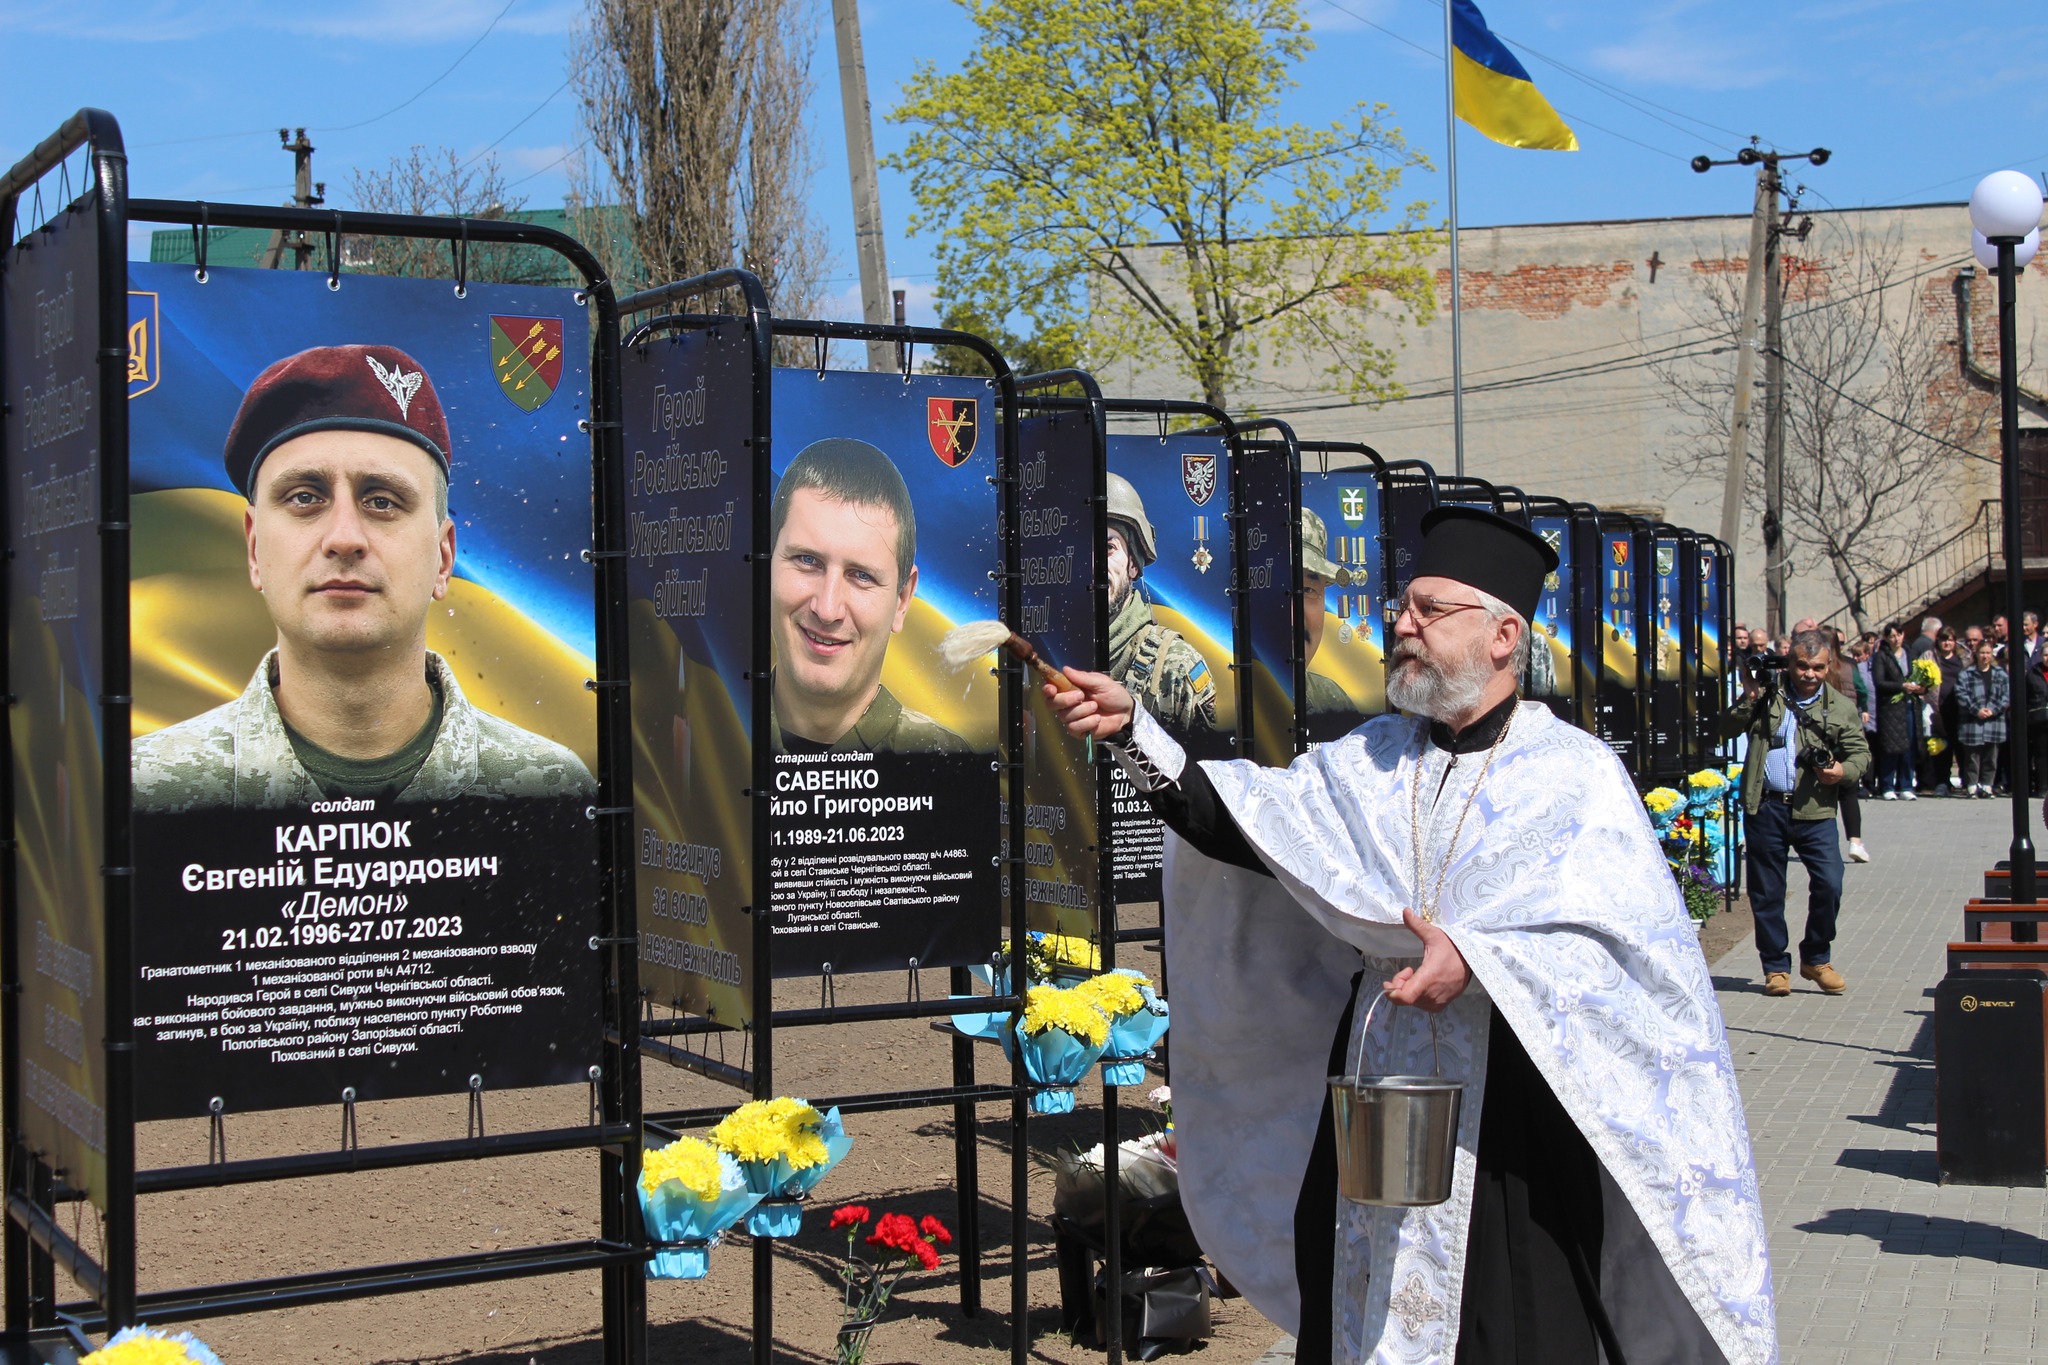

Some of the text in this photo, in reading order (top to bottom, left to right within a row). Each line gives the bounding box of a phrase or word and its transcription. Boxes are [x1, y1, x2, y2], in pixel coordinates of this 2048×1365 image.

[652, 376, 706, 440] Герой
[633, 444, 727, 496] Російсько-
[630, 502, 734, 567] Української
[654, 568, 708, 618] війни!
[775, 751, 874, 764] старший солдат
[776, 769, 879, 792] САВЕНКО
[311, 797, 376, 814] солдат
[814, 795, 933, 818] Григорович
[276, 821, 412, 854] КАРПЮК
[771, 826, 904, 846] 1.1989-21.06.2023
[182, 856, 498, 892] Євгеній Едуардович
[641, 828, 721, 885] Він загинув
[281, 890, 409, 924] «Демон»
[653, 886, 709, 926] за волю
[221, 916, 463, 951] 21.02.1996-27.07.2023
[141, 943, 537, 981] Гранатометник 1 механізованого відділення 2 механізованого взводу
[252, 962, 434, 986] 1 механізованої роти в/ч А4712.
[154, 1011, 218, 1025] виконання
[221, 1007, 276, 1020] бойового
[278, 1003, 336, 1017] завдання,
[340, 998, 383, 1013] мужньо
[386, 994, 446, 1007] виконуючи
[449, 986, 508, 1002] військовий
[187, 973, 494, 1008] Народився Герой в селі Сивухи Чернігівської області.
[156, 1002, 522, 1040] загинув, в бою за Україну, поблизу населеного пункту Роботине
[222, 1020, 464, 1050] Пологівського району Запорізької області.
[271, 1042, 418, 1062] Похований в селі Сивухи.
